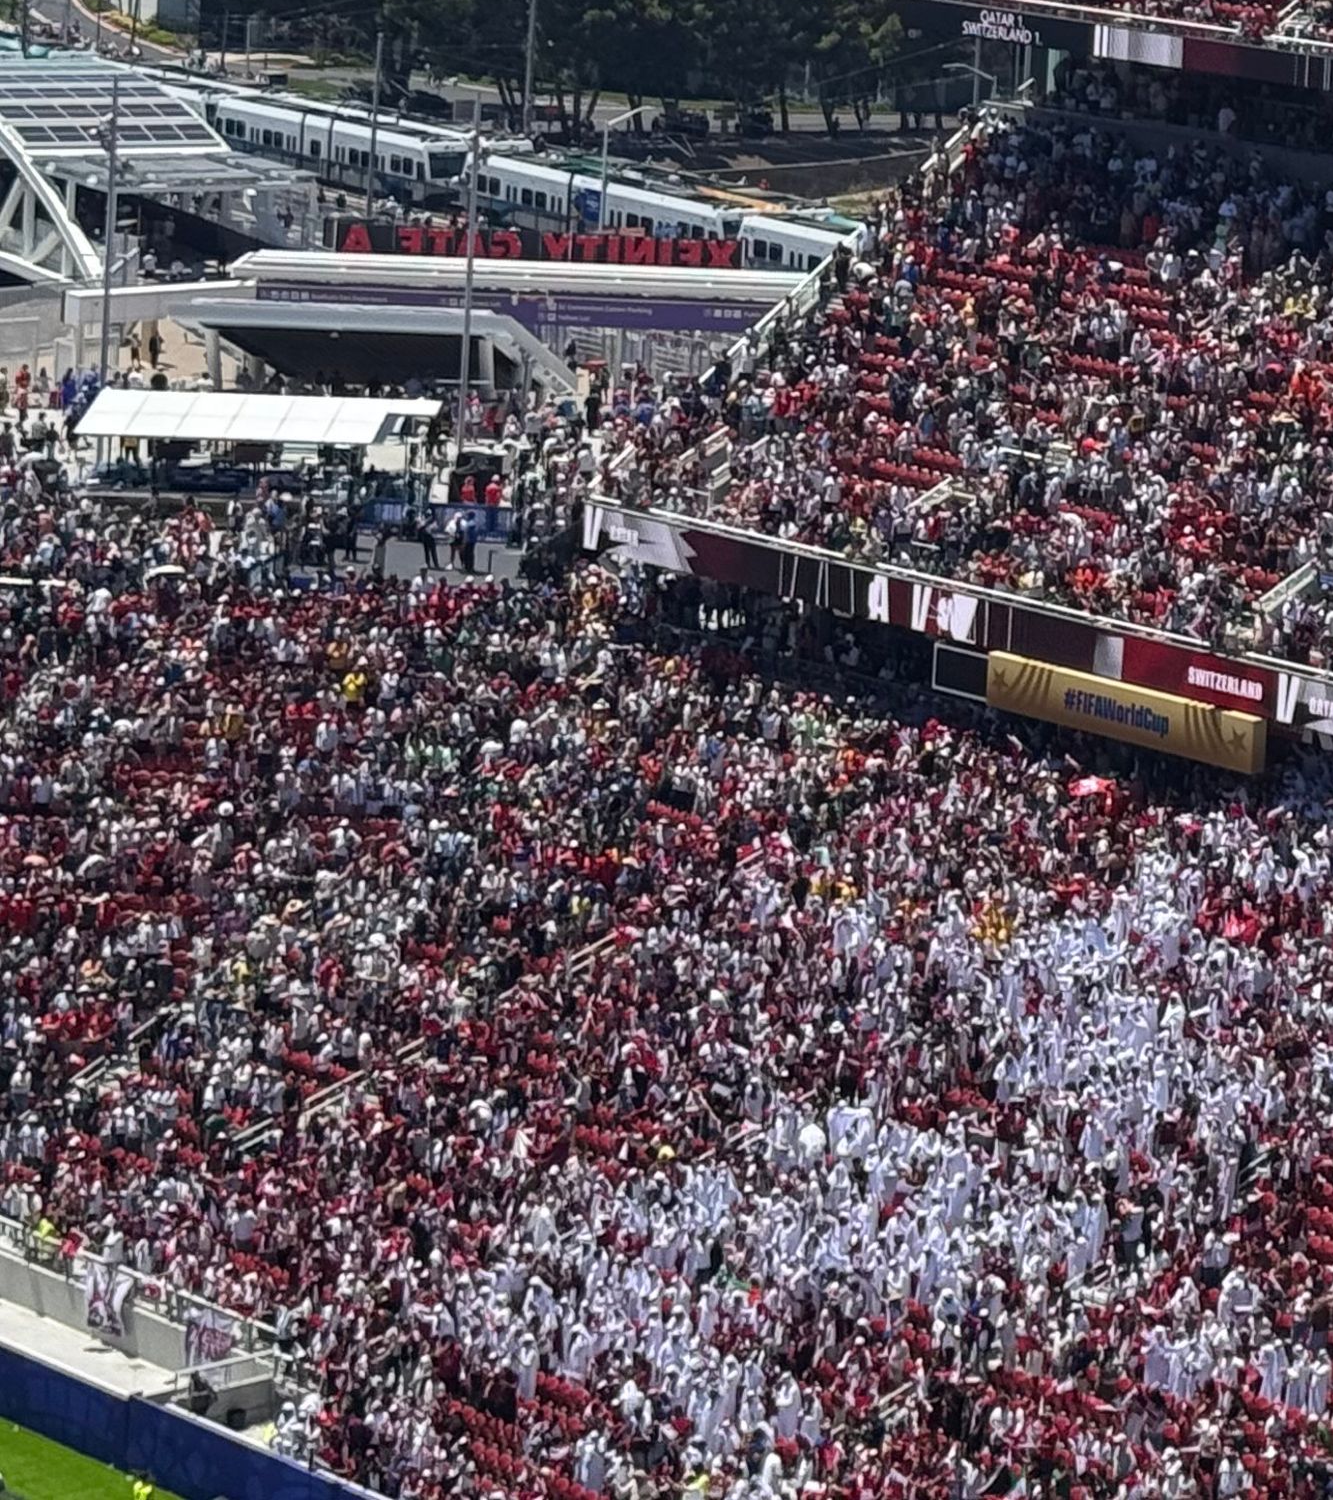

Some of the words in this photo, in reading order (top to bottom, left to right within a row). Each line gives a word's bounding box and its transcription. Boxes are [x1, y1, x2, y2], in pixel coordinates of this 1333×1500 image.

[962, 20, 1032, 45] SWITZERLAND
[980, 9, 1015, 28] QATAR
[1187, 665, 1263, 701] SWITZERLAND
[1063, 687, 1170, 739] #FIFAWorldCup
